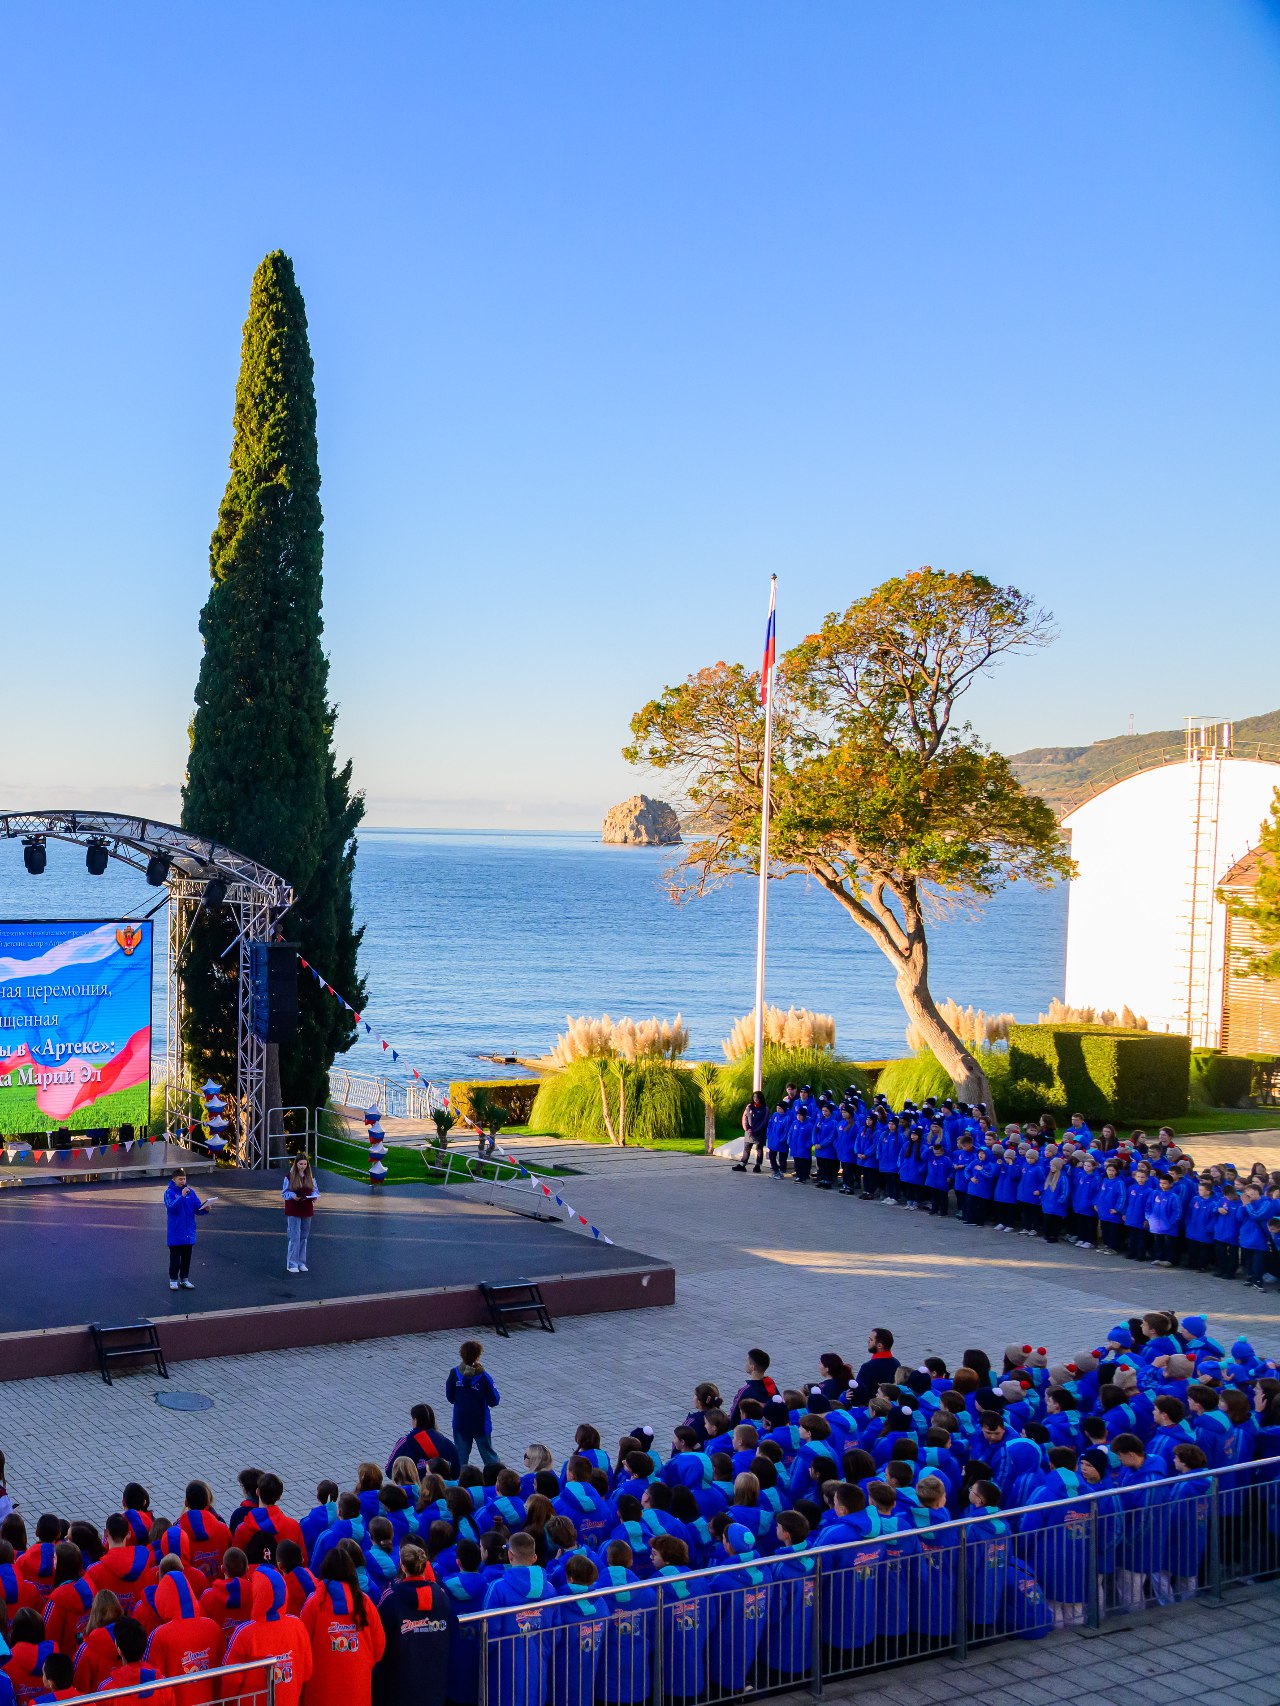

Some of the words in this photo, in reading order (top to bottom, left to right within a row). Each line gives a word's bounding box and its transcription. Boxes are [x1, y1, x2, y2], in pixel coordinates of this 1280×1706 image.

[26, 983, 113, 1005] церемония,
[17, 1044, 26, 1056] в
[31, 1038, 116, 1061] «Артеке»:
[17, 1066, 75, 1090] Марий
[80, 1066, 102, 1083] Эл
